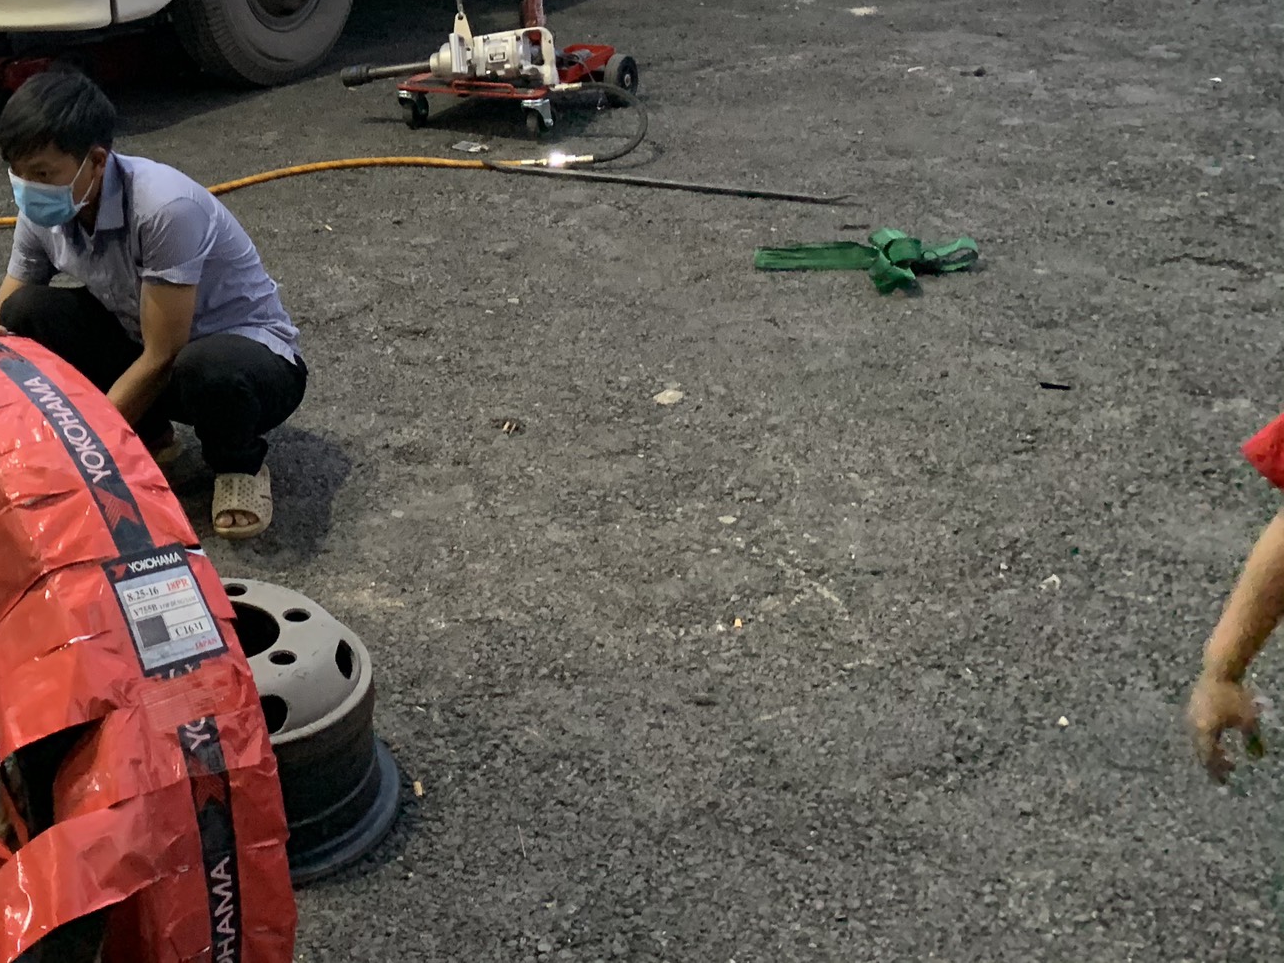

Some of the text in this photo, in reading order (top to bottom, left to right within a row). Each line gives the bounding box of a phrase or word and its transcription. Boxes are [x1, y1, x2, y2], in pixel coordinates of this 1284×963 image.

[24, 376, 112, 484] YOKOHAMA
[128, 552, 182, 573] YOKOHAMA
[126, 578, 190, 602] 8.25-16 18PR
[194, 637, 217, 649] JAPAN
